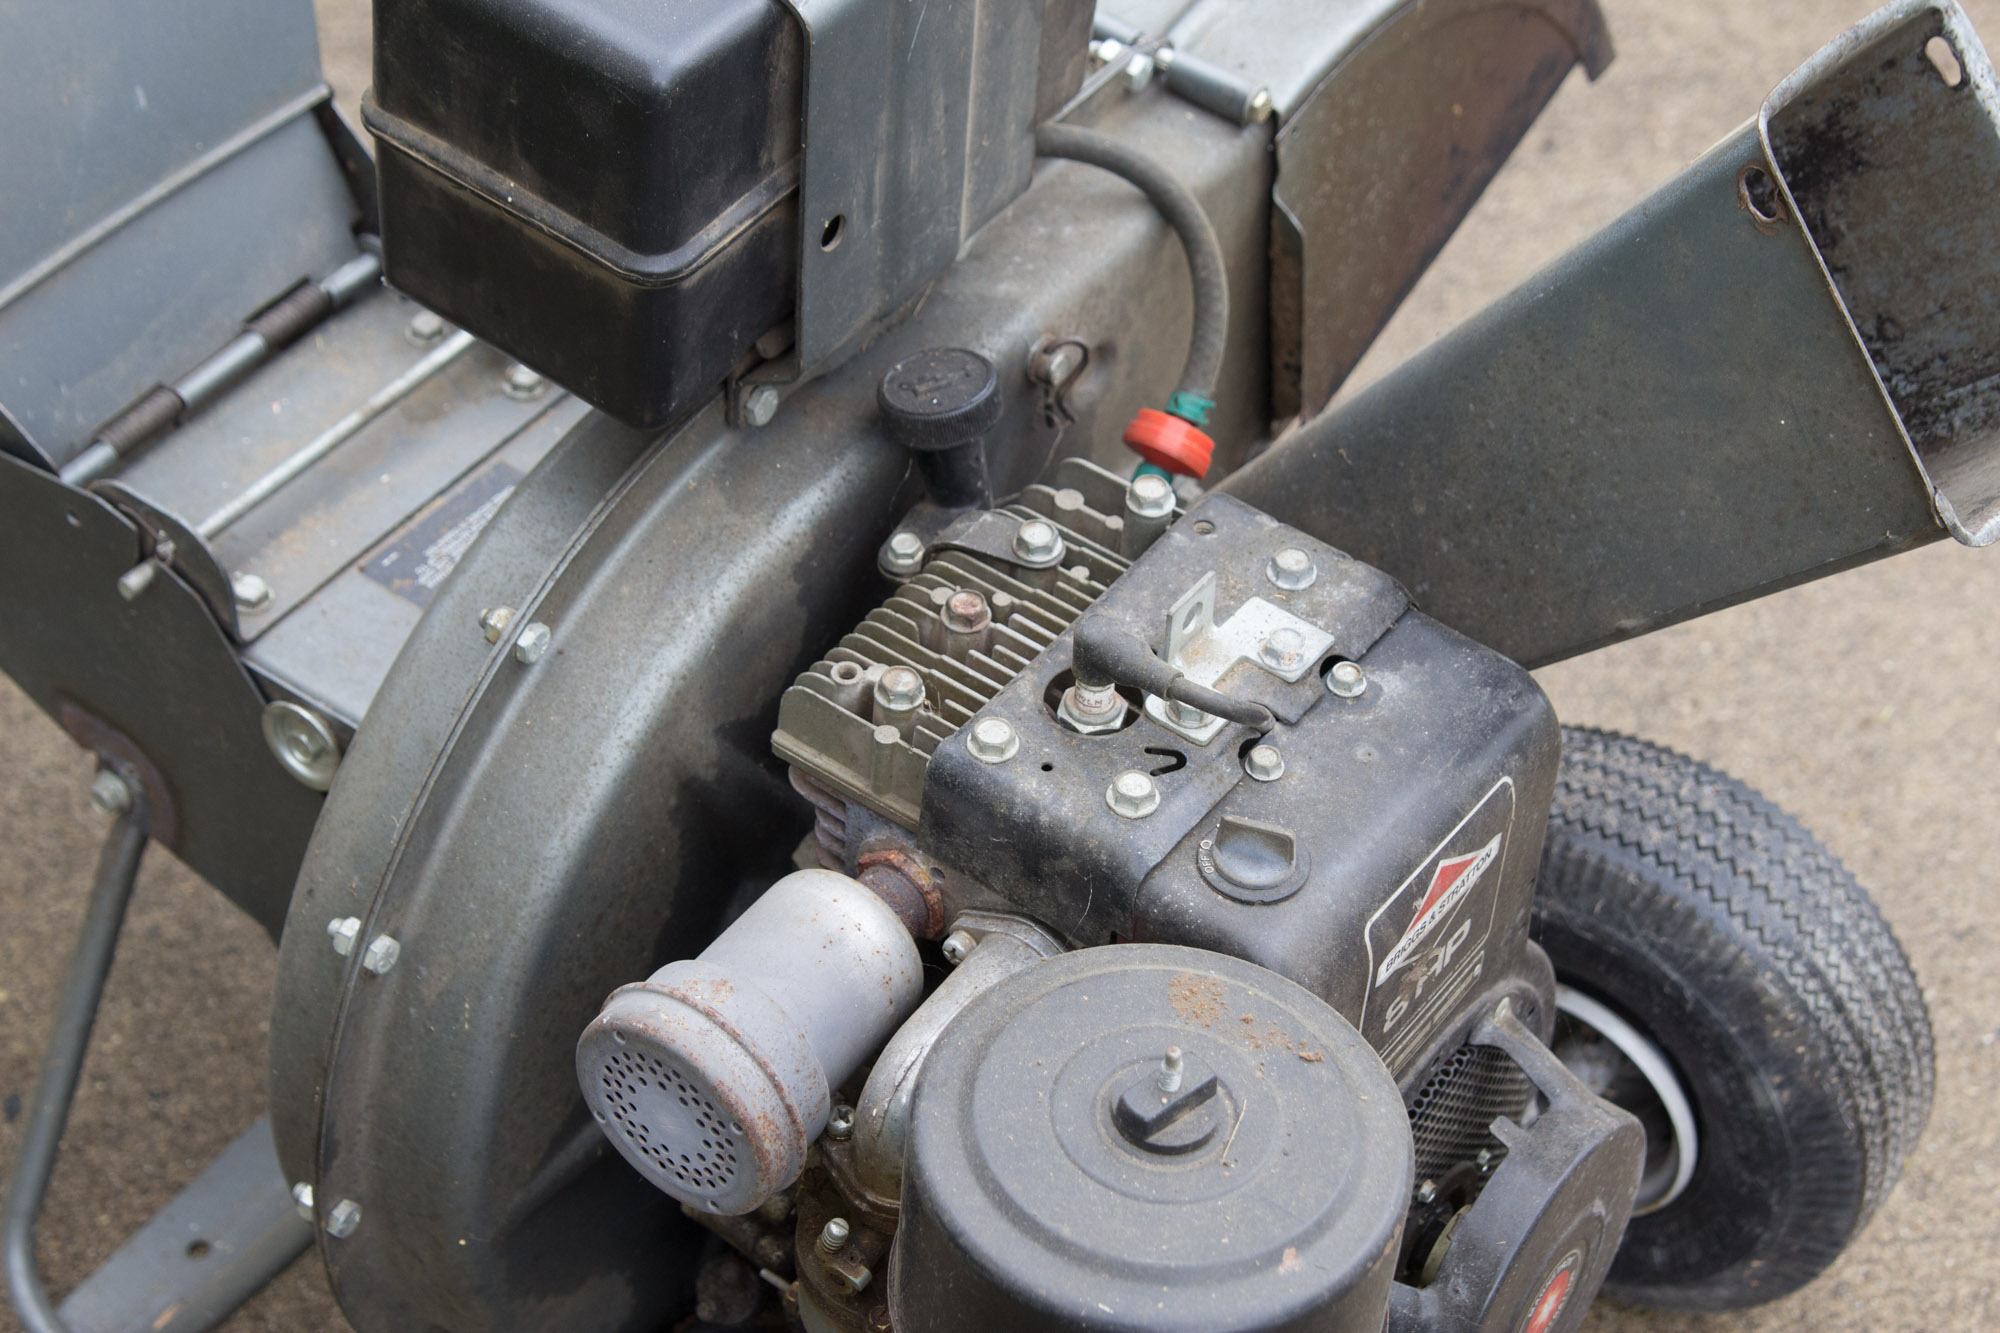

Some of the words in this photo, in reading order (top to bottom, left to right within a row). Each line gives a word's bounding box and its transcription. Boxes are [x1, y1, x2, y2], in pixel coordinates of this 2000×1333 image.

[1200, 855, 1214, 874] OFF
[1386, 923, 1427, 973] BRIGGS
[1428, 909, 1437, 925] &
[1438, 848, 1493, 914] STRATTON
